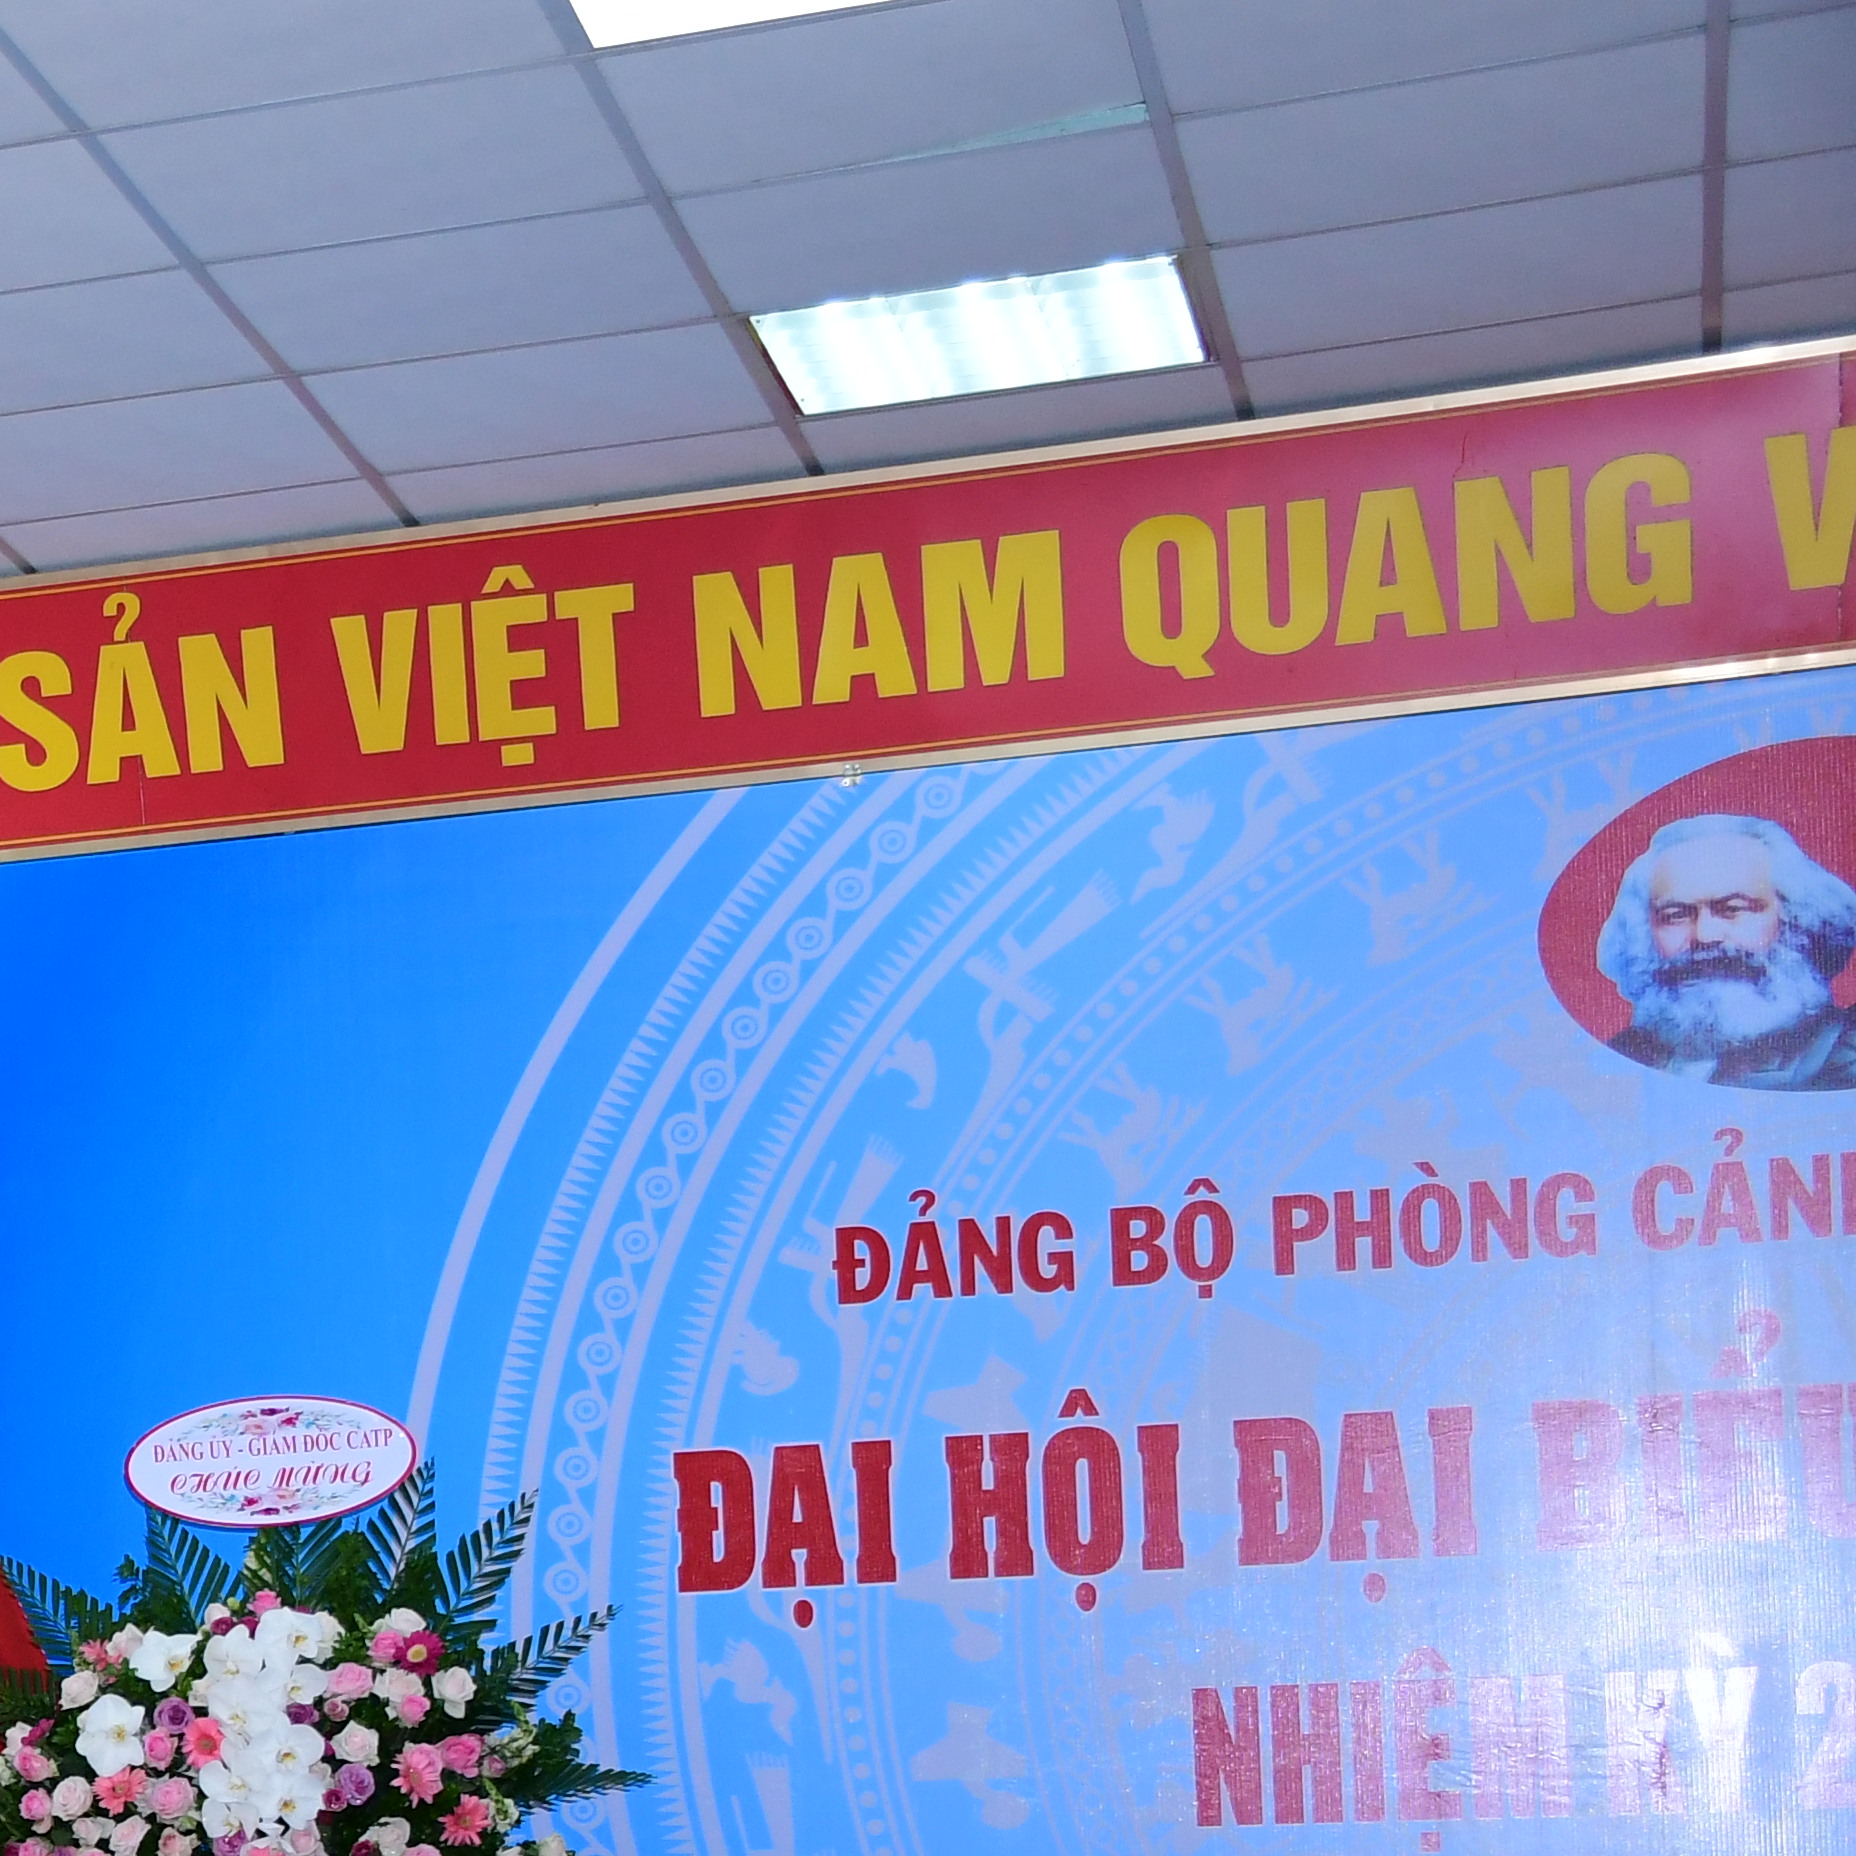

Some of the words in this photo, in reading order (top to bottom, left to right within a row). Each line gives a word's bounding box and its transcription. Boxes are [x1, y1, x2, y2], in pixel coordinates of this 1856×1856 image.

[330, 564, 635, 767] VIỆT
[692, 529, 1066, 719] NAM
[1119, 452, 1693, 680] QUANG
[1764, 424, 1856, 591] V
[832, 1190, 1076, 1305] ĐẢNG
[1110, 1177, 1234, 1300] BỘ
[1271, 1162, 1596, 1276] PHÒNG
[1632, 1127, 1856, 1251] CẢN
[153, 1437, 203, 1463] ĐẢNG
[247, 1430, 297, 1457] GIÁM
[302, 1427, 340, 1453] ĐỐC
[346, 1427, 393, 1449] CATP
[673, 1438, 899, 1628] ĐẠI
[945, 1387, 1186, 1612] HỘI
[1234, 1405, 1478, 1602] ĐẠI
[1531, 1308, 1856, 1552] BIỂU
[1191, 1646, 1572, 1852] NHIỆM
[1604, 1631, 1760, 1817] KỲ
